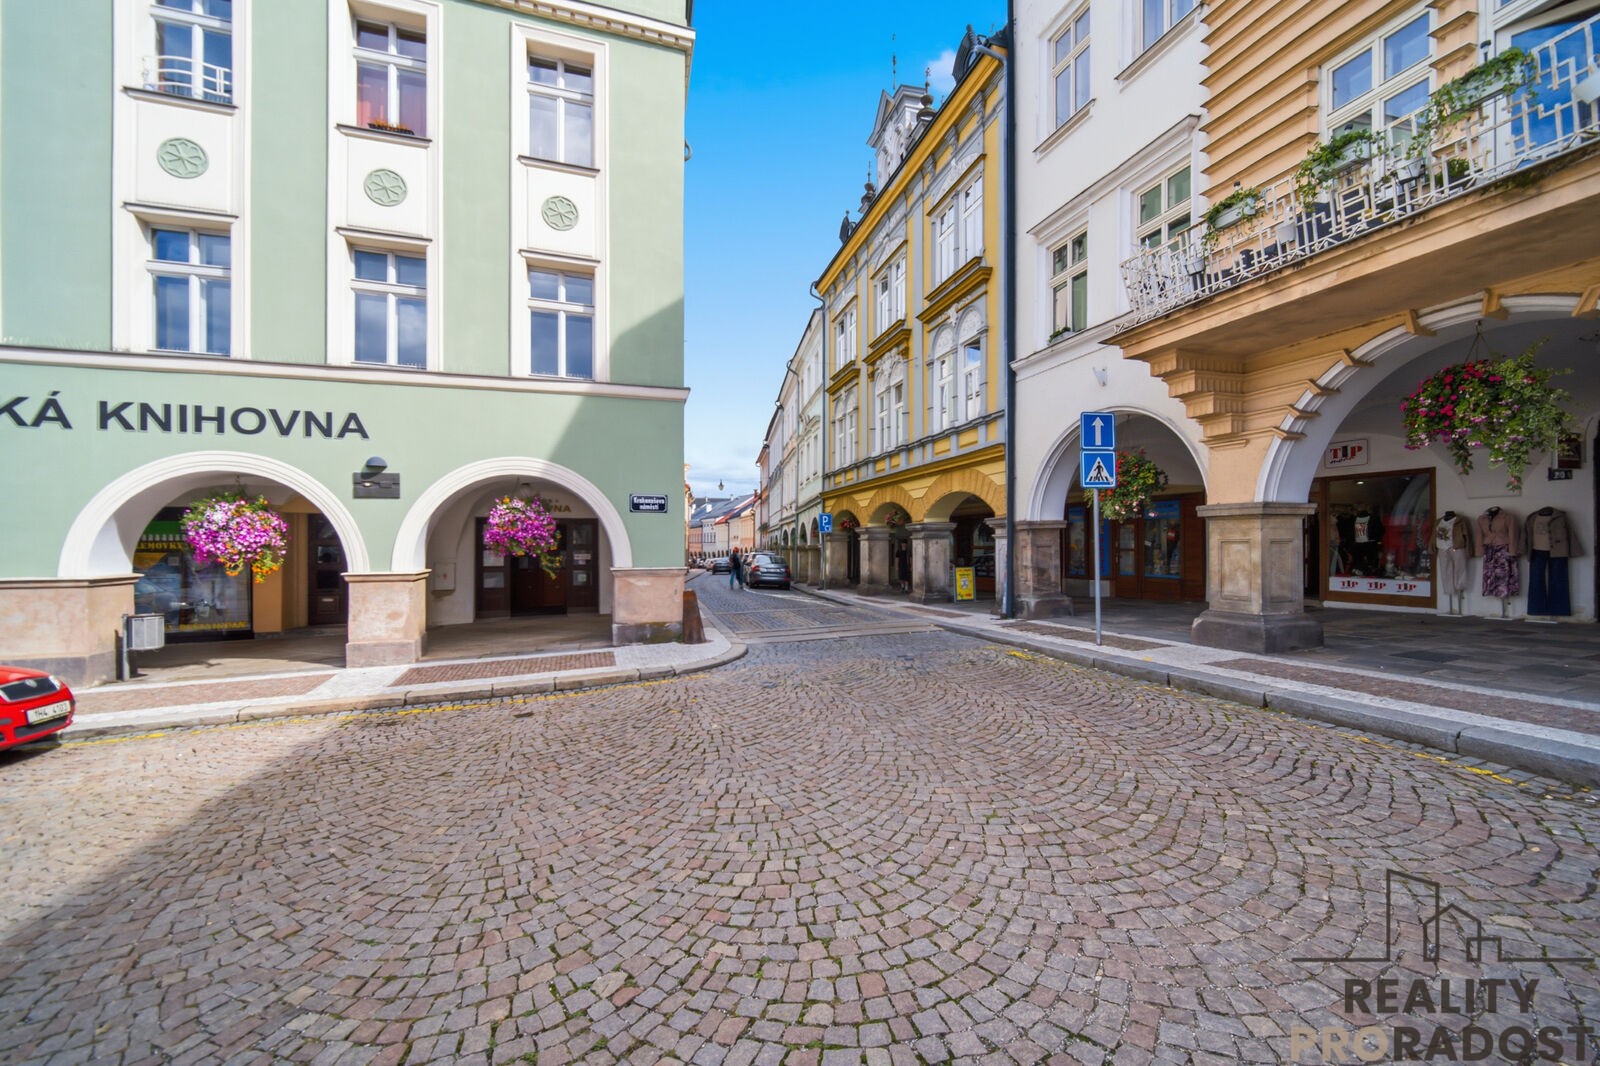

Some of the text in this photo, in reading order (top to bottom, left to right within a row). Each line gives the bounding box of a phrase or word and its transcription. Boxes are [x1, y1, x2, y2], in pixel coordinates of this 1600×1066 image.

[99, 400, 370, 440] KNIHOVNA
[1330, 446, 1363, 459] TIP
[822, 515, 829, 527] P
